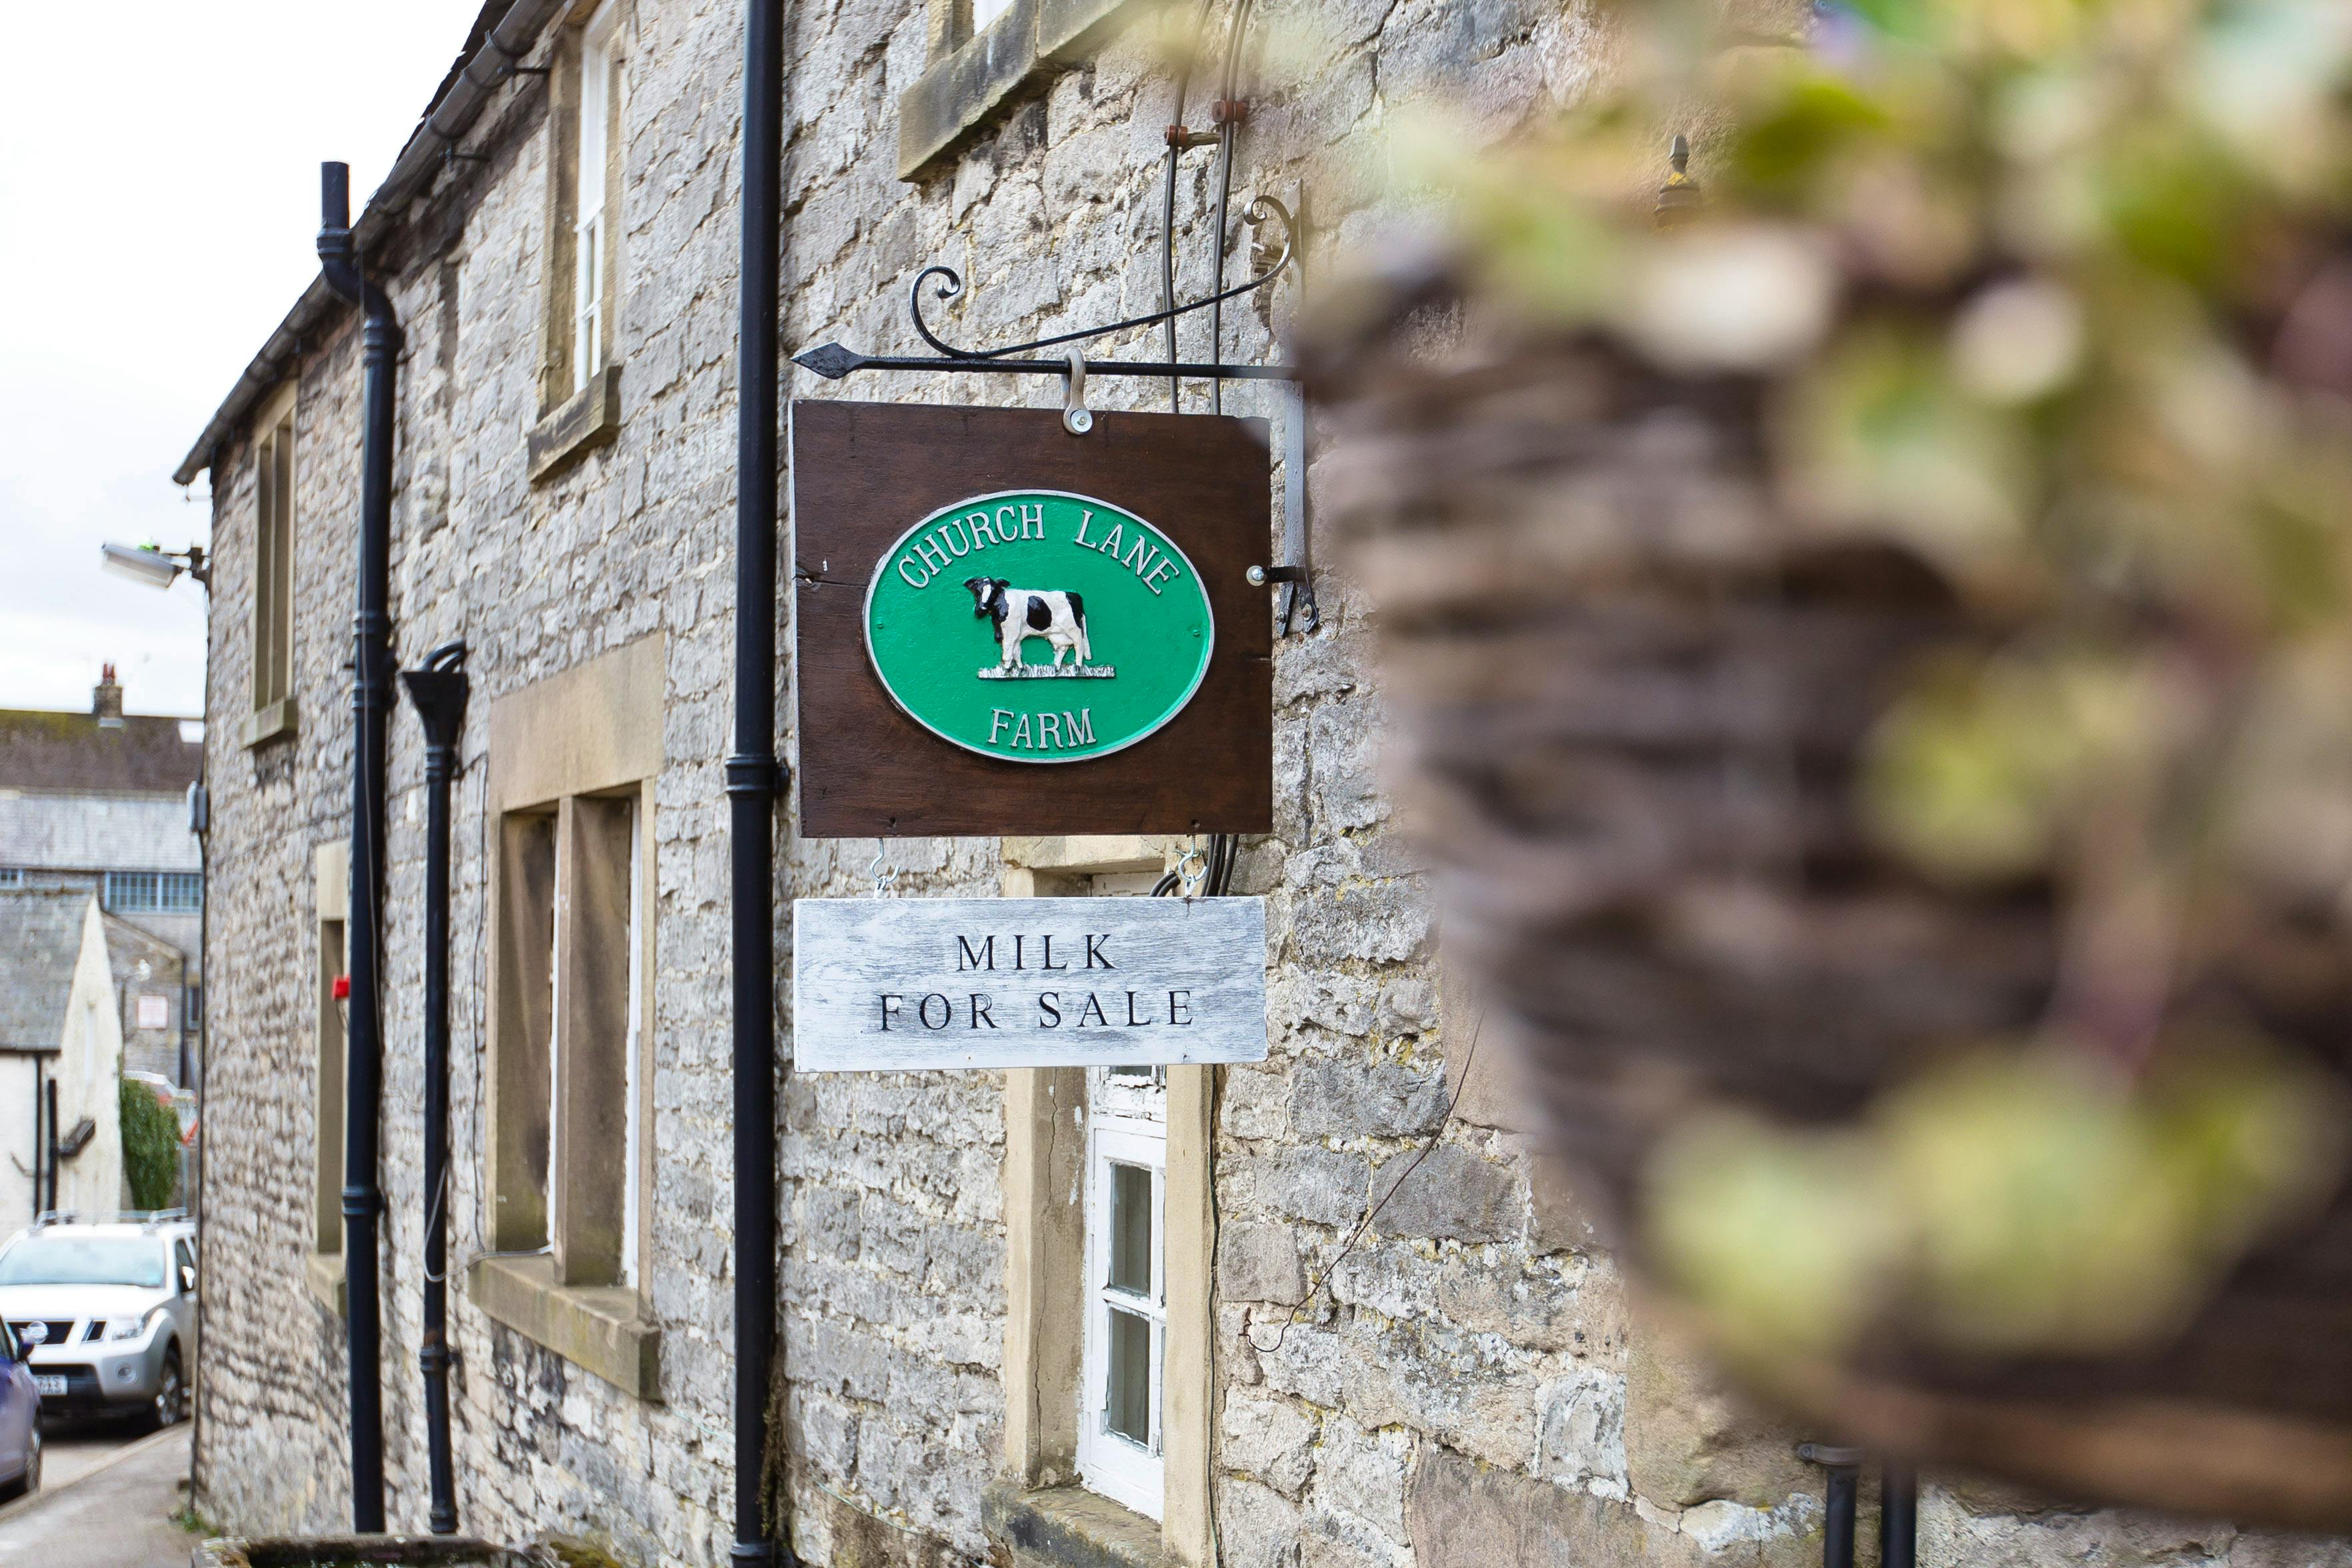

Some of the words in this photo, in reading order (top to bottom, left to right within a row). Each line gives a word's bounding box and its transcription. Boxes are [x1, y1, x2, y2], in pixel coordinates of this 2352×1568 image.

[898, 504, 1045, 589] CHURCH
[1075, 509, 1180, 595] LANE
[987, 708, 1097, 749] FARM
[956, 934, 1116, 971] MILK
[877, 993, 999, 1031] FOR
[1039, 990, 1193, 1029] SALE
